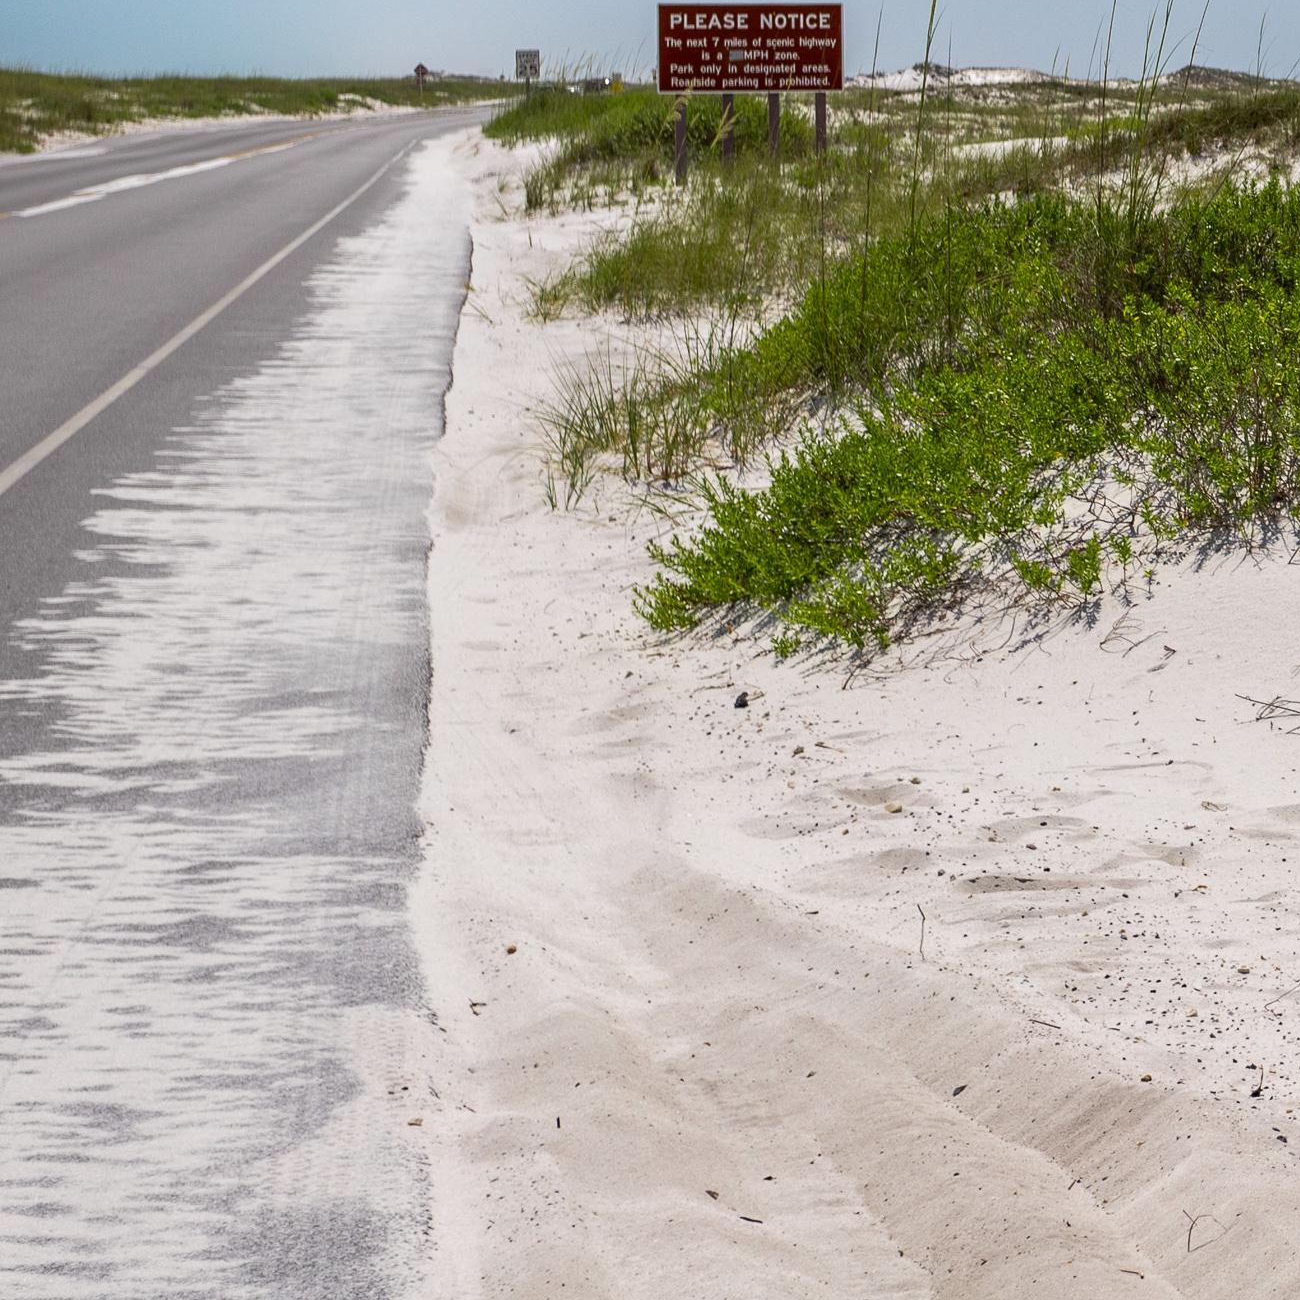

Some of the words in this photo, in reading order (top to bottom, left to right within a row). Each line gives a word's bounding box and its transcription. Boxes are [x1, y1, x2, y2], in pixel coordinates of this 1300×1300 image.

[670, 13, 749, 30] PLEASE
[760, 13, 831, 29] NOTICE
[665, 37, 682, 47] The
[687, 37, 707, 47] next
[712, 37, 719, 47] 7
[724, 37, 747, 47] miles
[752, 37, 762, 47] of
[766, 37, 795, 47] scenic
[799, 37, 837, 49] highway
[701, 50, 710, 61] is
[716, 52, 723, 61] a
[774, 51, 801, 61] zone.
[670, 63, 694, 74] Park
[700, 63, 722, 76] only
[728, 63, 738, 74] in
[743, 63, 796, 76] designated
[802, 63, 831, 74] areas.
[671, 76, 716, 87] Roadside
[722, 76, 759, 88] parking
[765, 76, 773, 86] is
